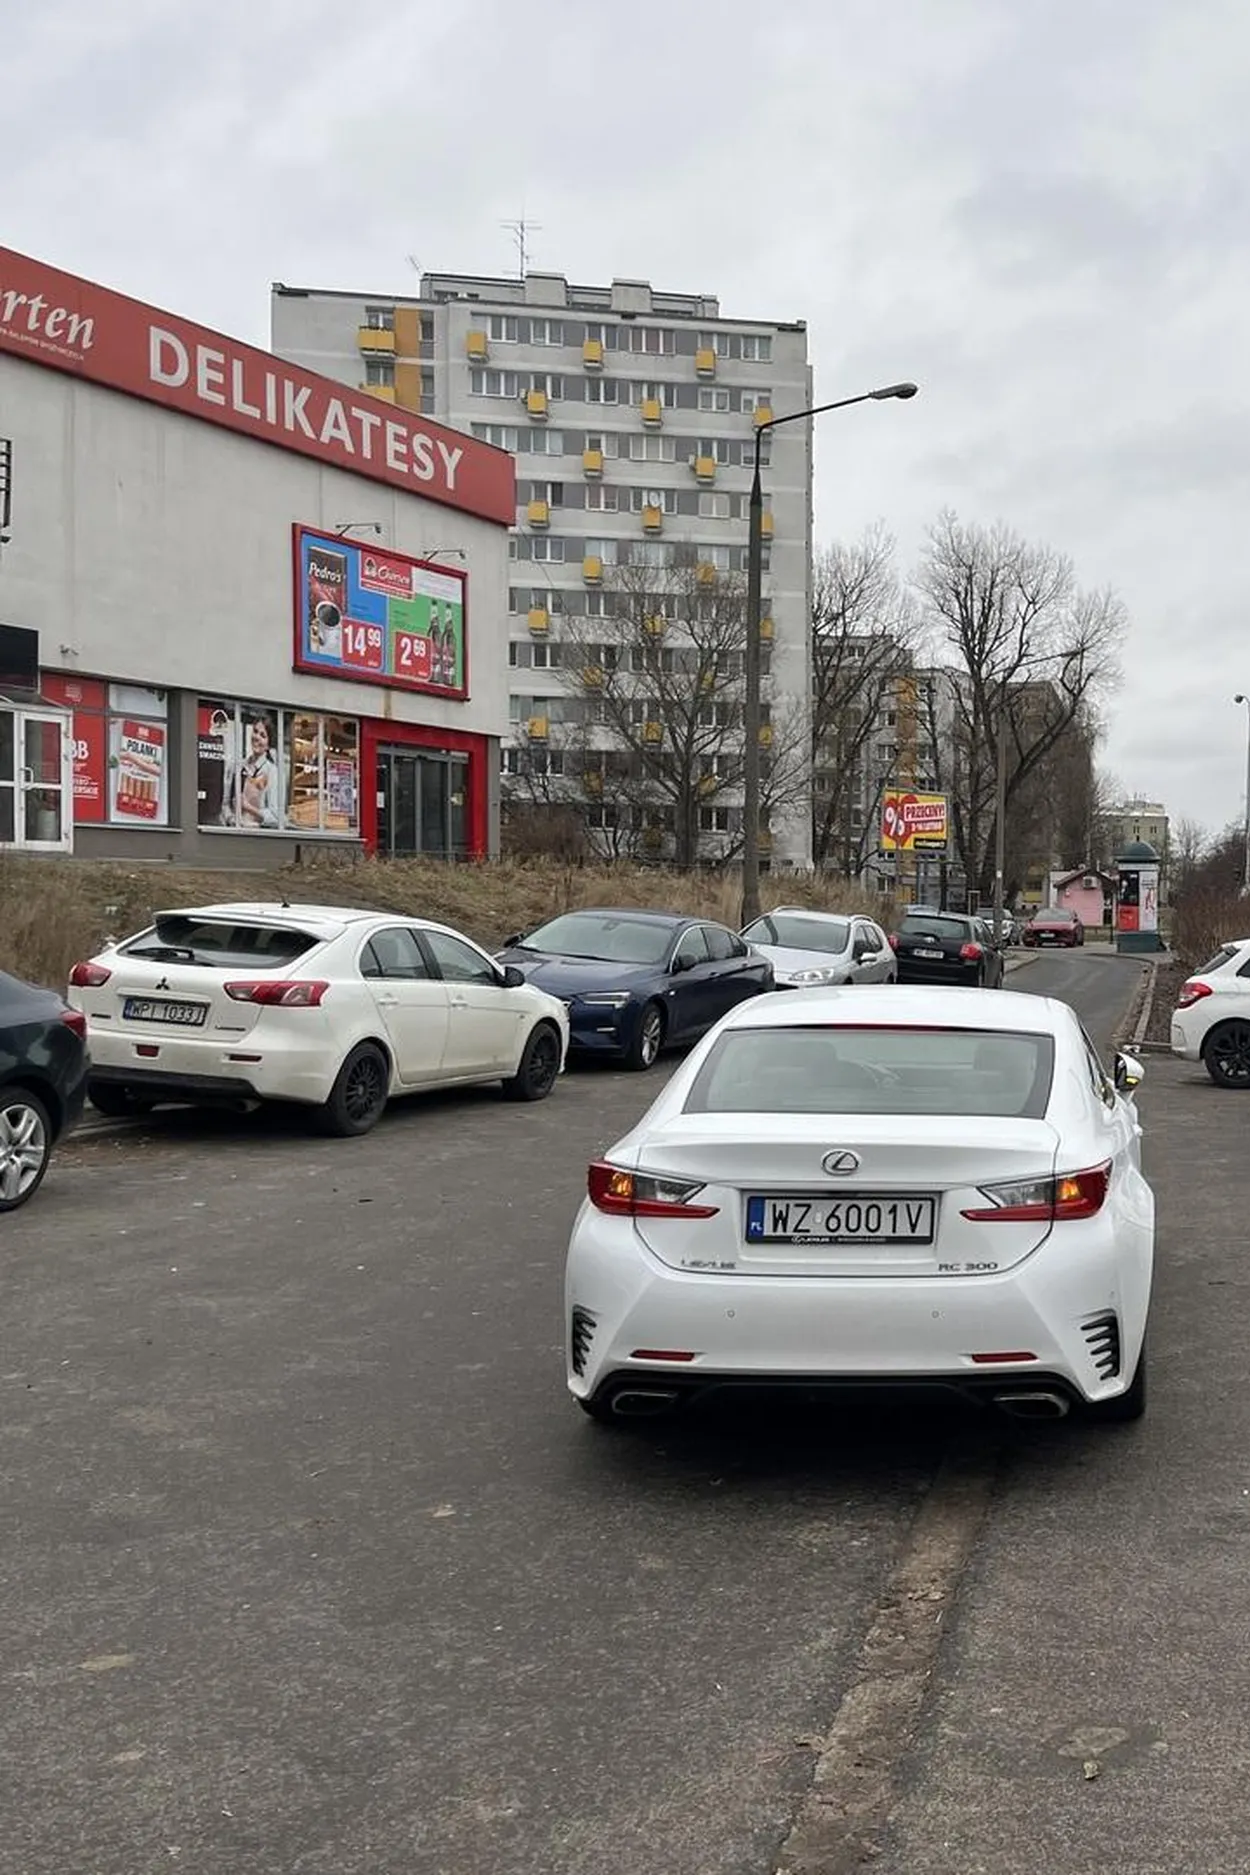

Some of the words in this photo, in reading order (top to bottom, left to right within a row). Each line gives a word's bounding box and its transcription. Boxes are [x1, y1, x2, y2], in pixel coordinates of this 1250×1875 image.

[0, 290, 94, 349] rten
[149, 325, 462, 490] DELIKATESY
[772, 1203, 812, 1233] WZ
[825, 1203, 923, 1234] 6001V
